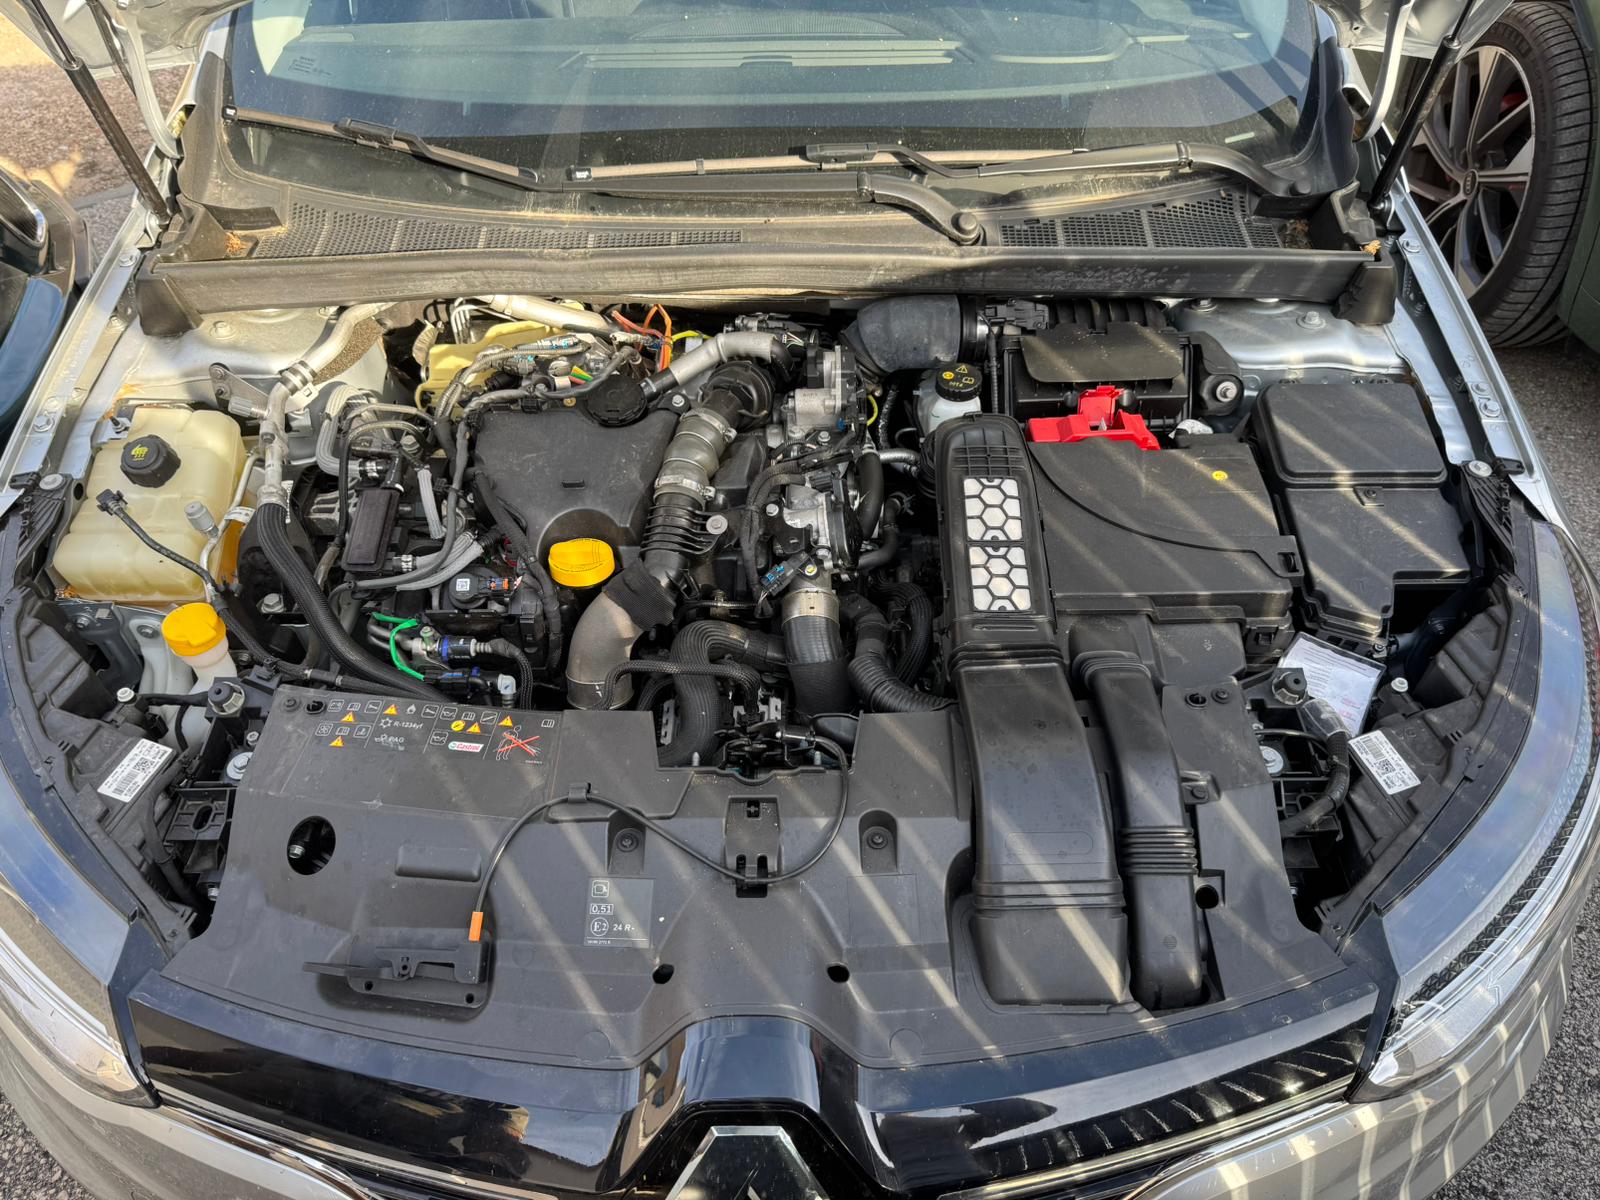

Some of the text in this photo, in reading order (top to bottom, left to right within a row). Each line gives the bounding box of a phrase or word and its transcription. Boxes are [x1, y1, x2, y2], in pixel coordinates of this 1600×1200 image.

[393, 720, 424, 729] R-1234yf
[456, 742, 482, 751] Castrol
[591, 905, 611, 914] 0,51
[593, 921, 607, 932] E2
